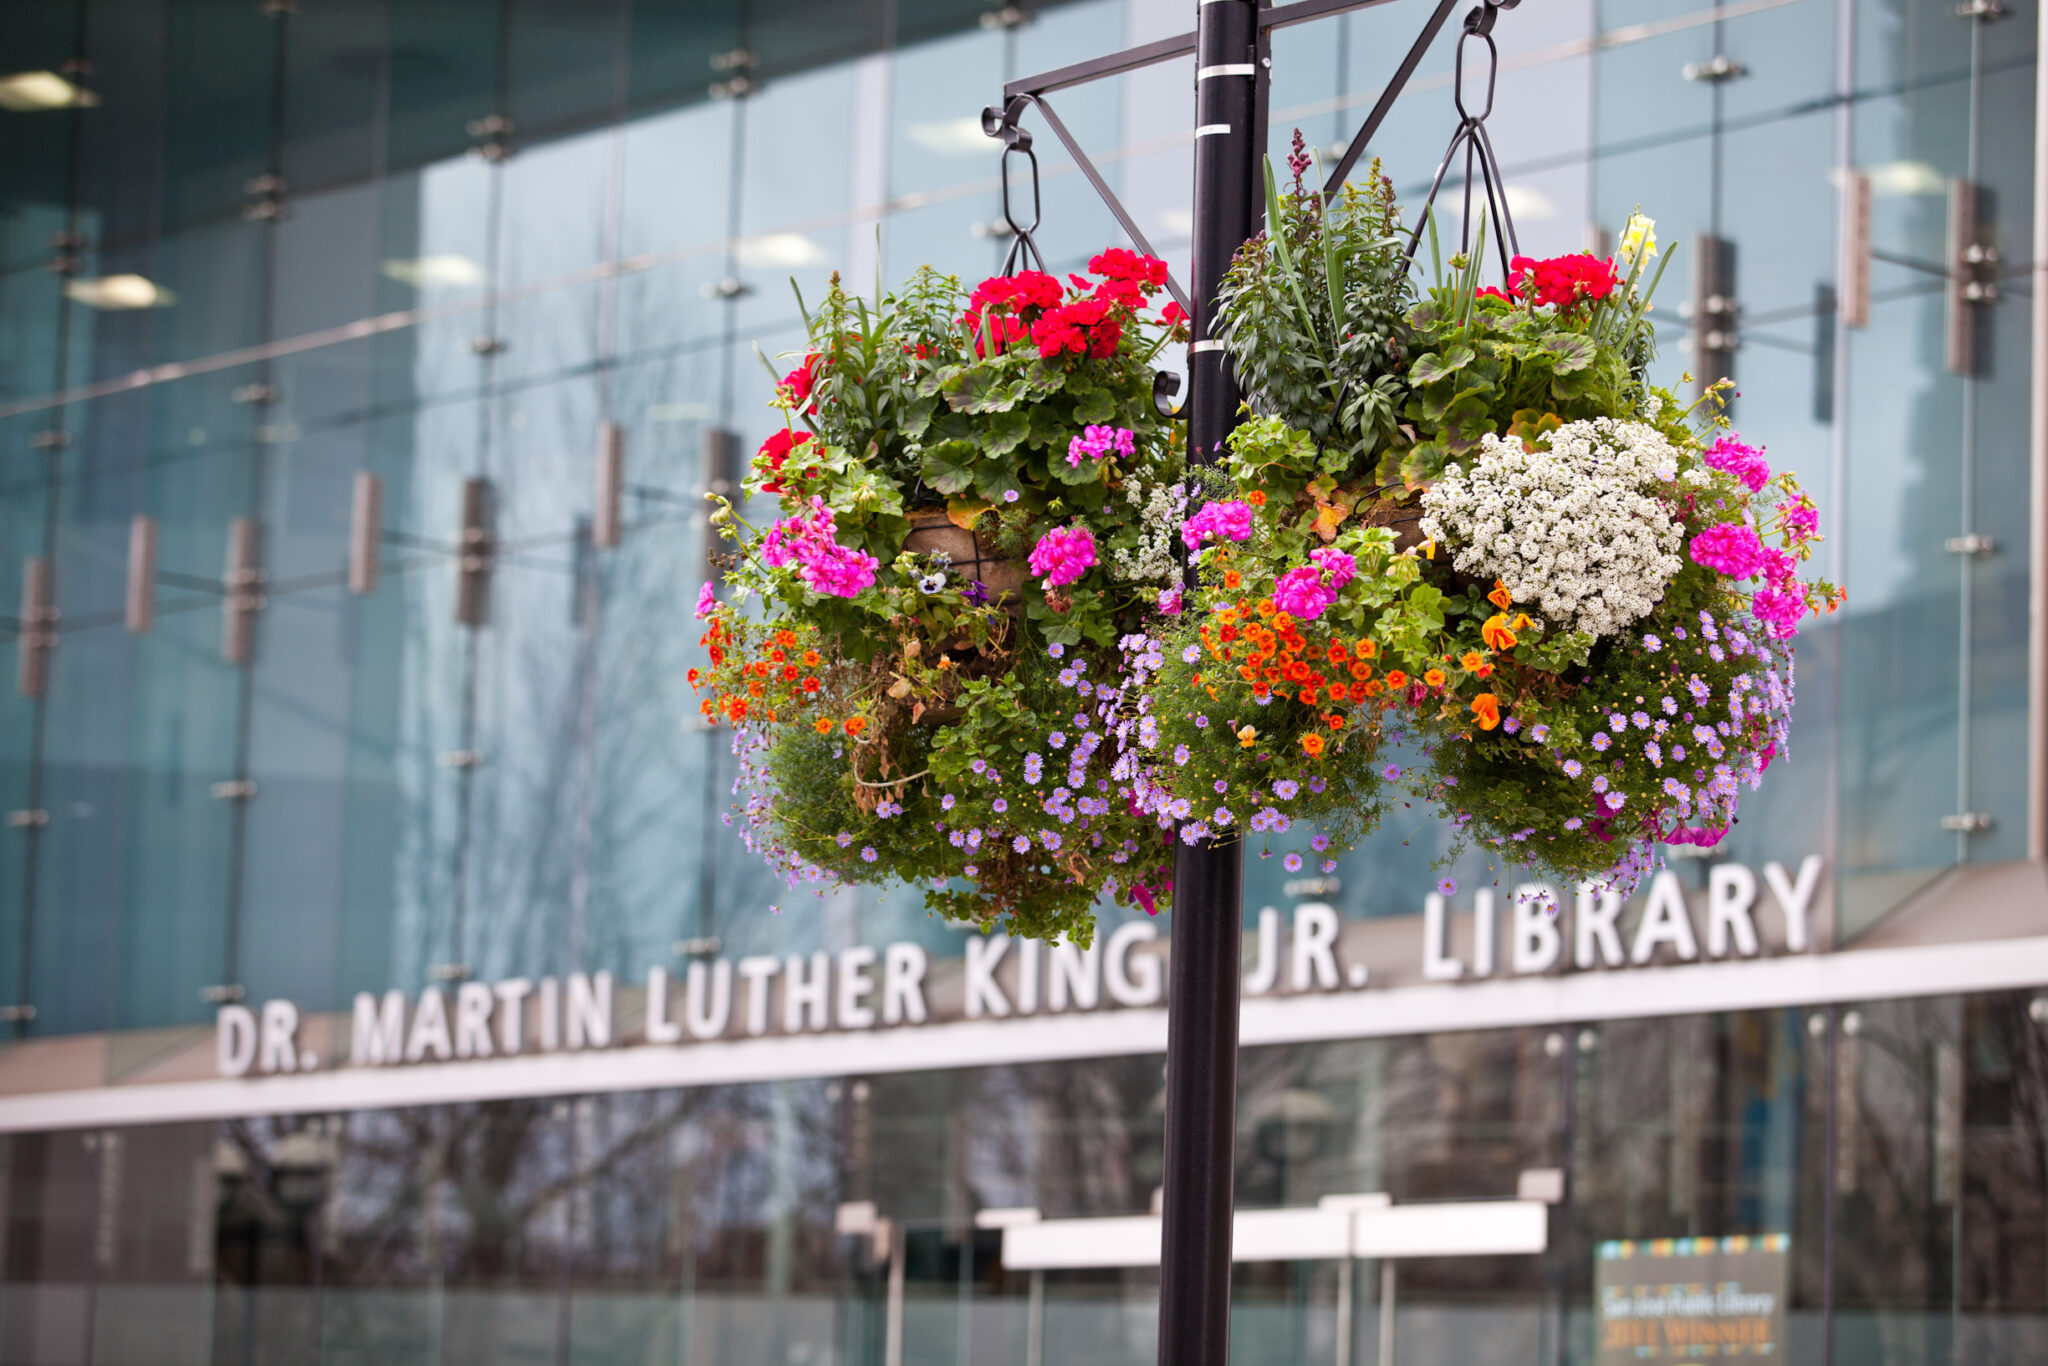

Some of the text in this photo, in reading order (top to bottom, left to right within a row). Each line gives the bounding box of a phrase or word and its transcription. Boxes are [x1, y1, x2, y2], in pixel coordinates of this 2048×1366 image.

[216, 854, 1823, 1078] DR. MARTIN LUTHER KING JR. LIBRARY
[1716, 1291, 1774, 1319] Library
[1664, 1318, 1771, 1345] WINNER
